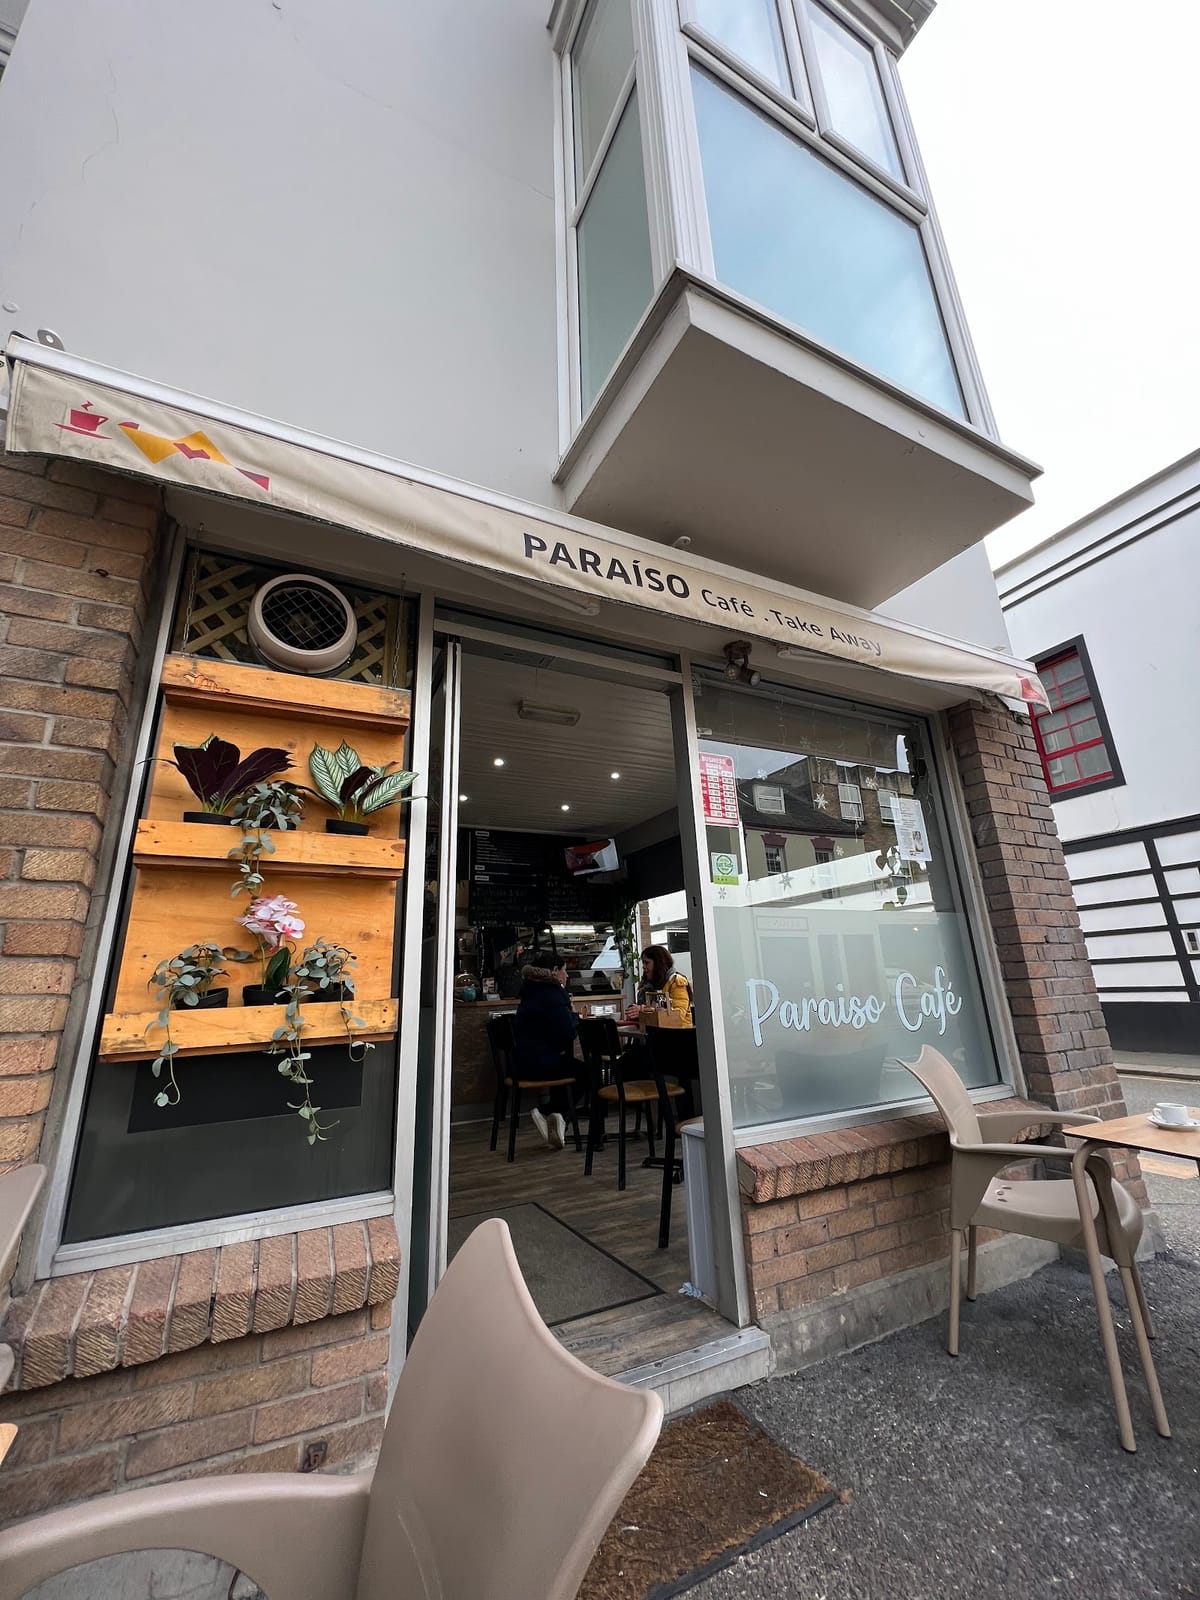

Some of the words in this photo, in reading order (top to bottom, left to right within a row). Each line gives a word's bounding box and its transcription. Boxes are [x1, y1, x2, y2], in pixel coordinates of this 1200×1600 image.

[523, 532, 690, 599] PARAÍSO
[701, 588, 755, 618] Café
[830, 626, 882, 656] Away
[745, 977, 886, 1047] Paraiso
[895, 965, 962, 1036] Café
